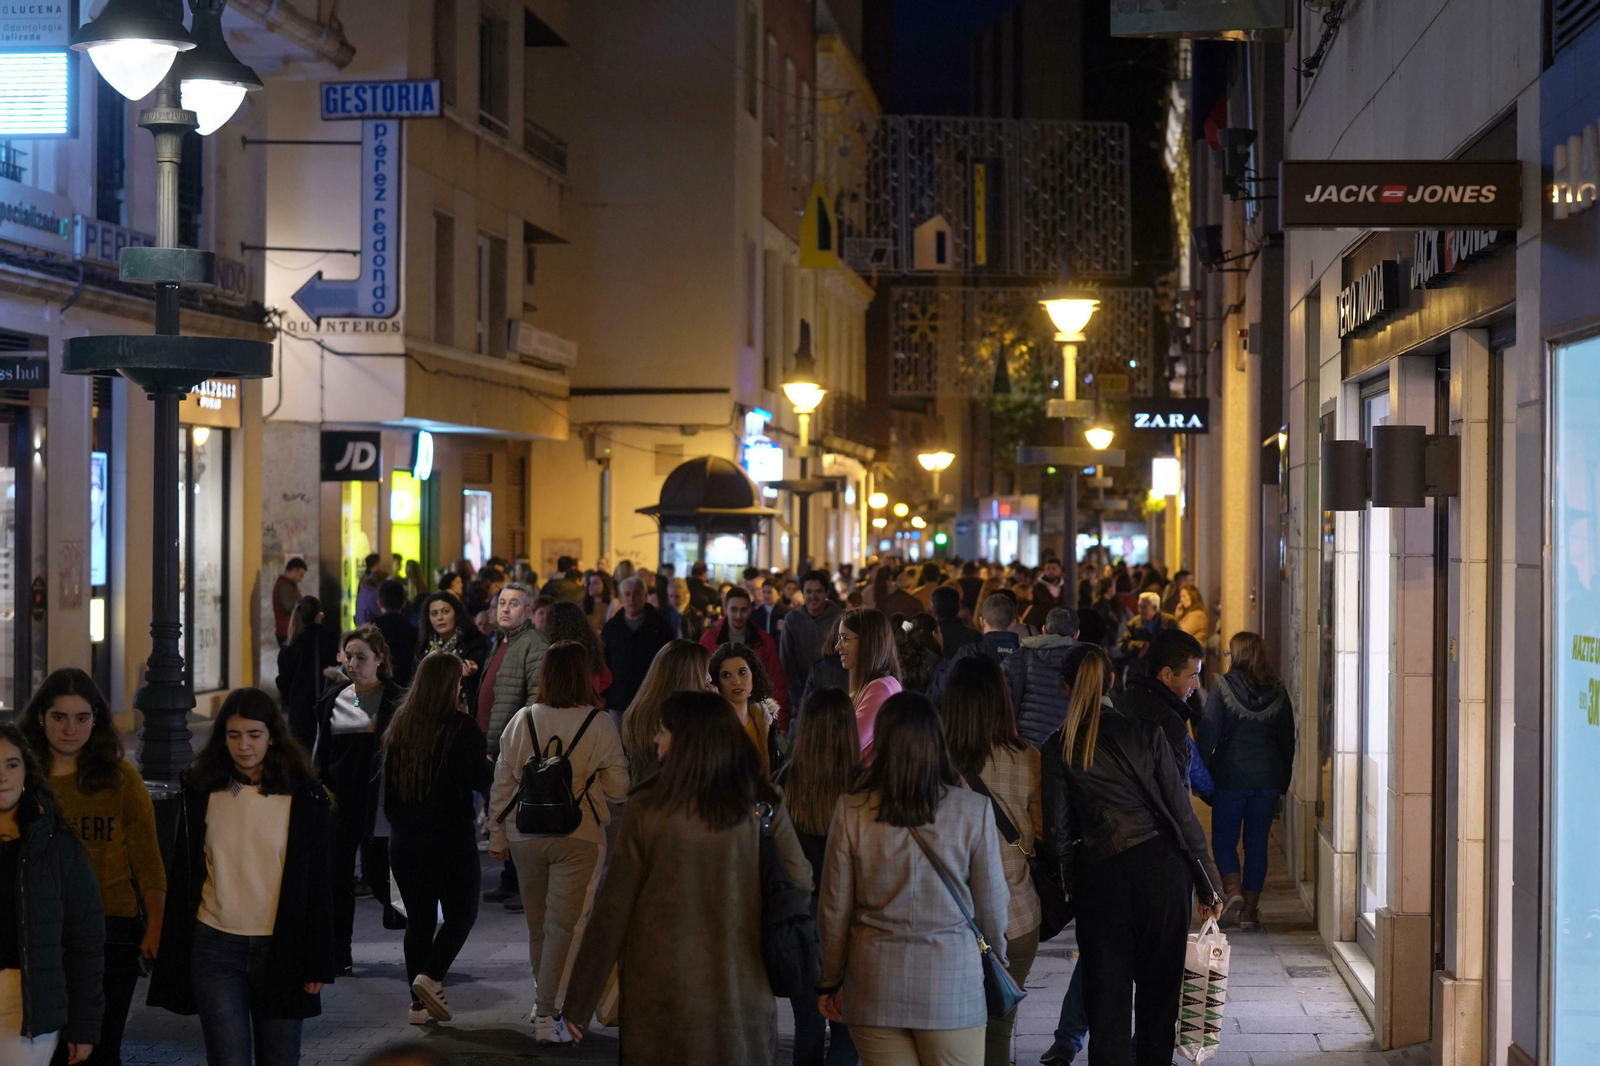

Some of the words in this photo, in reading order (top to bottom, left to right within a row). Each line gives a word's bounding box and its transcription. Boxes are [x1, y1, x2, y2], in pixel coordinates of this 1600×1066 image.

[325, 83, 435, 114] GESTORIA
[1304, 185, 1379, 203] JACK
[1407, 185, 1497, 203] JONES
[372, 208, 386, 315] redondo
[1336, 281, 1356, 339] VERO
[1358, 259, 1385, 326] MODA
[1134, 413, 1204, 429] ZARA
[334, 441, 377, 472] JD
